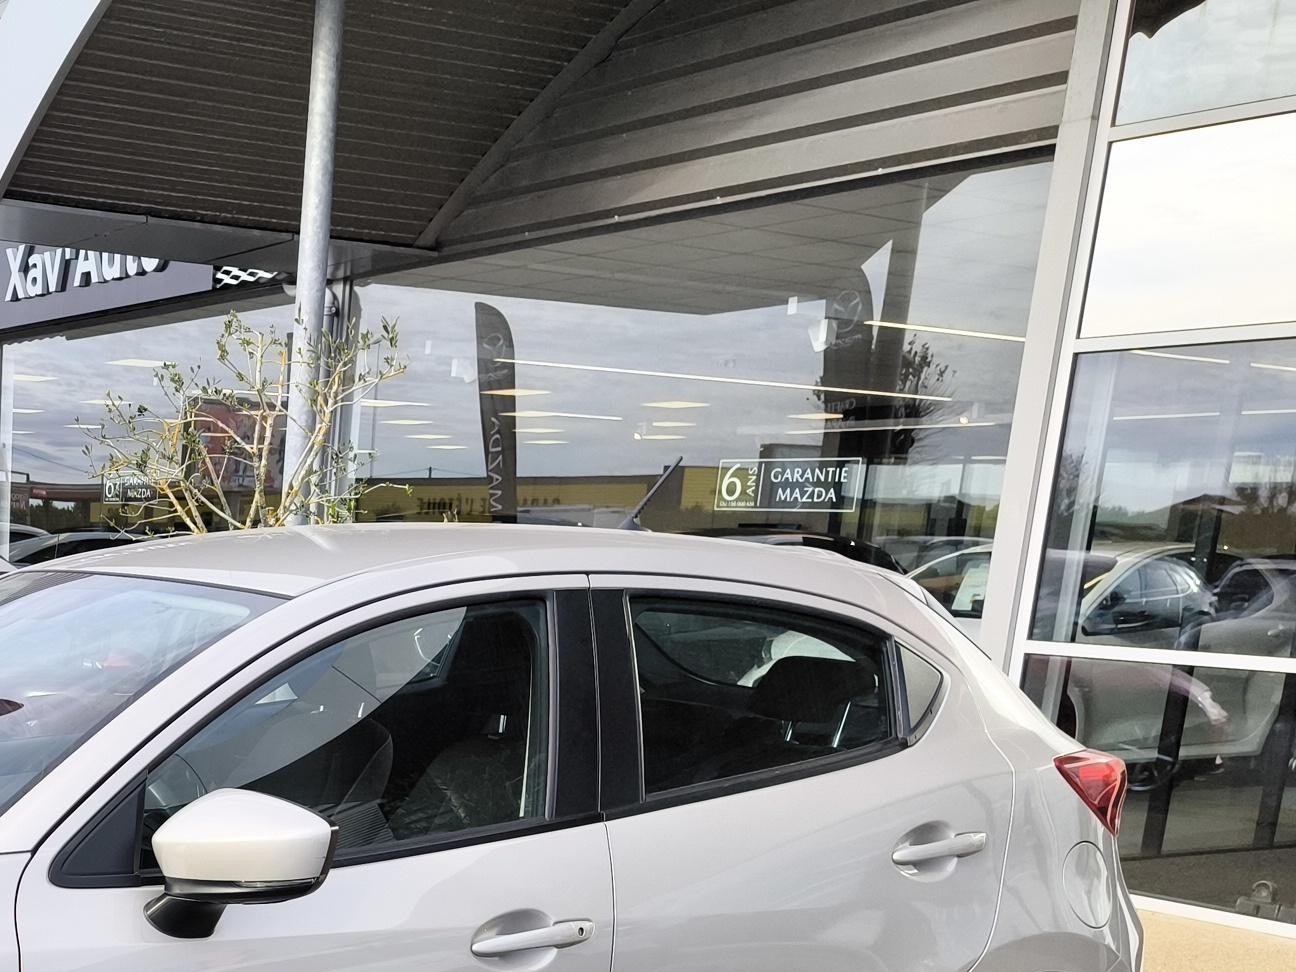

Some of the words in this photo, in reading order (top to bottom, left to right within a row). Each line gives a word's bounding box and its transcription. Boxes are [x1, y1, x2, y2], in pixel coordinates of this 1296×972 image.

[721, 463, 741, 501] 6
[746, 466, 758, 497] ANS
[770, 467, 849, 483] GARANTIE
[775, 487, 837, 502] MAZDA
